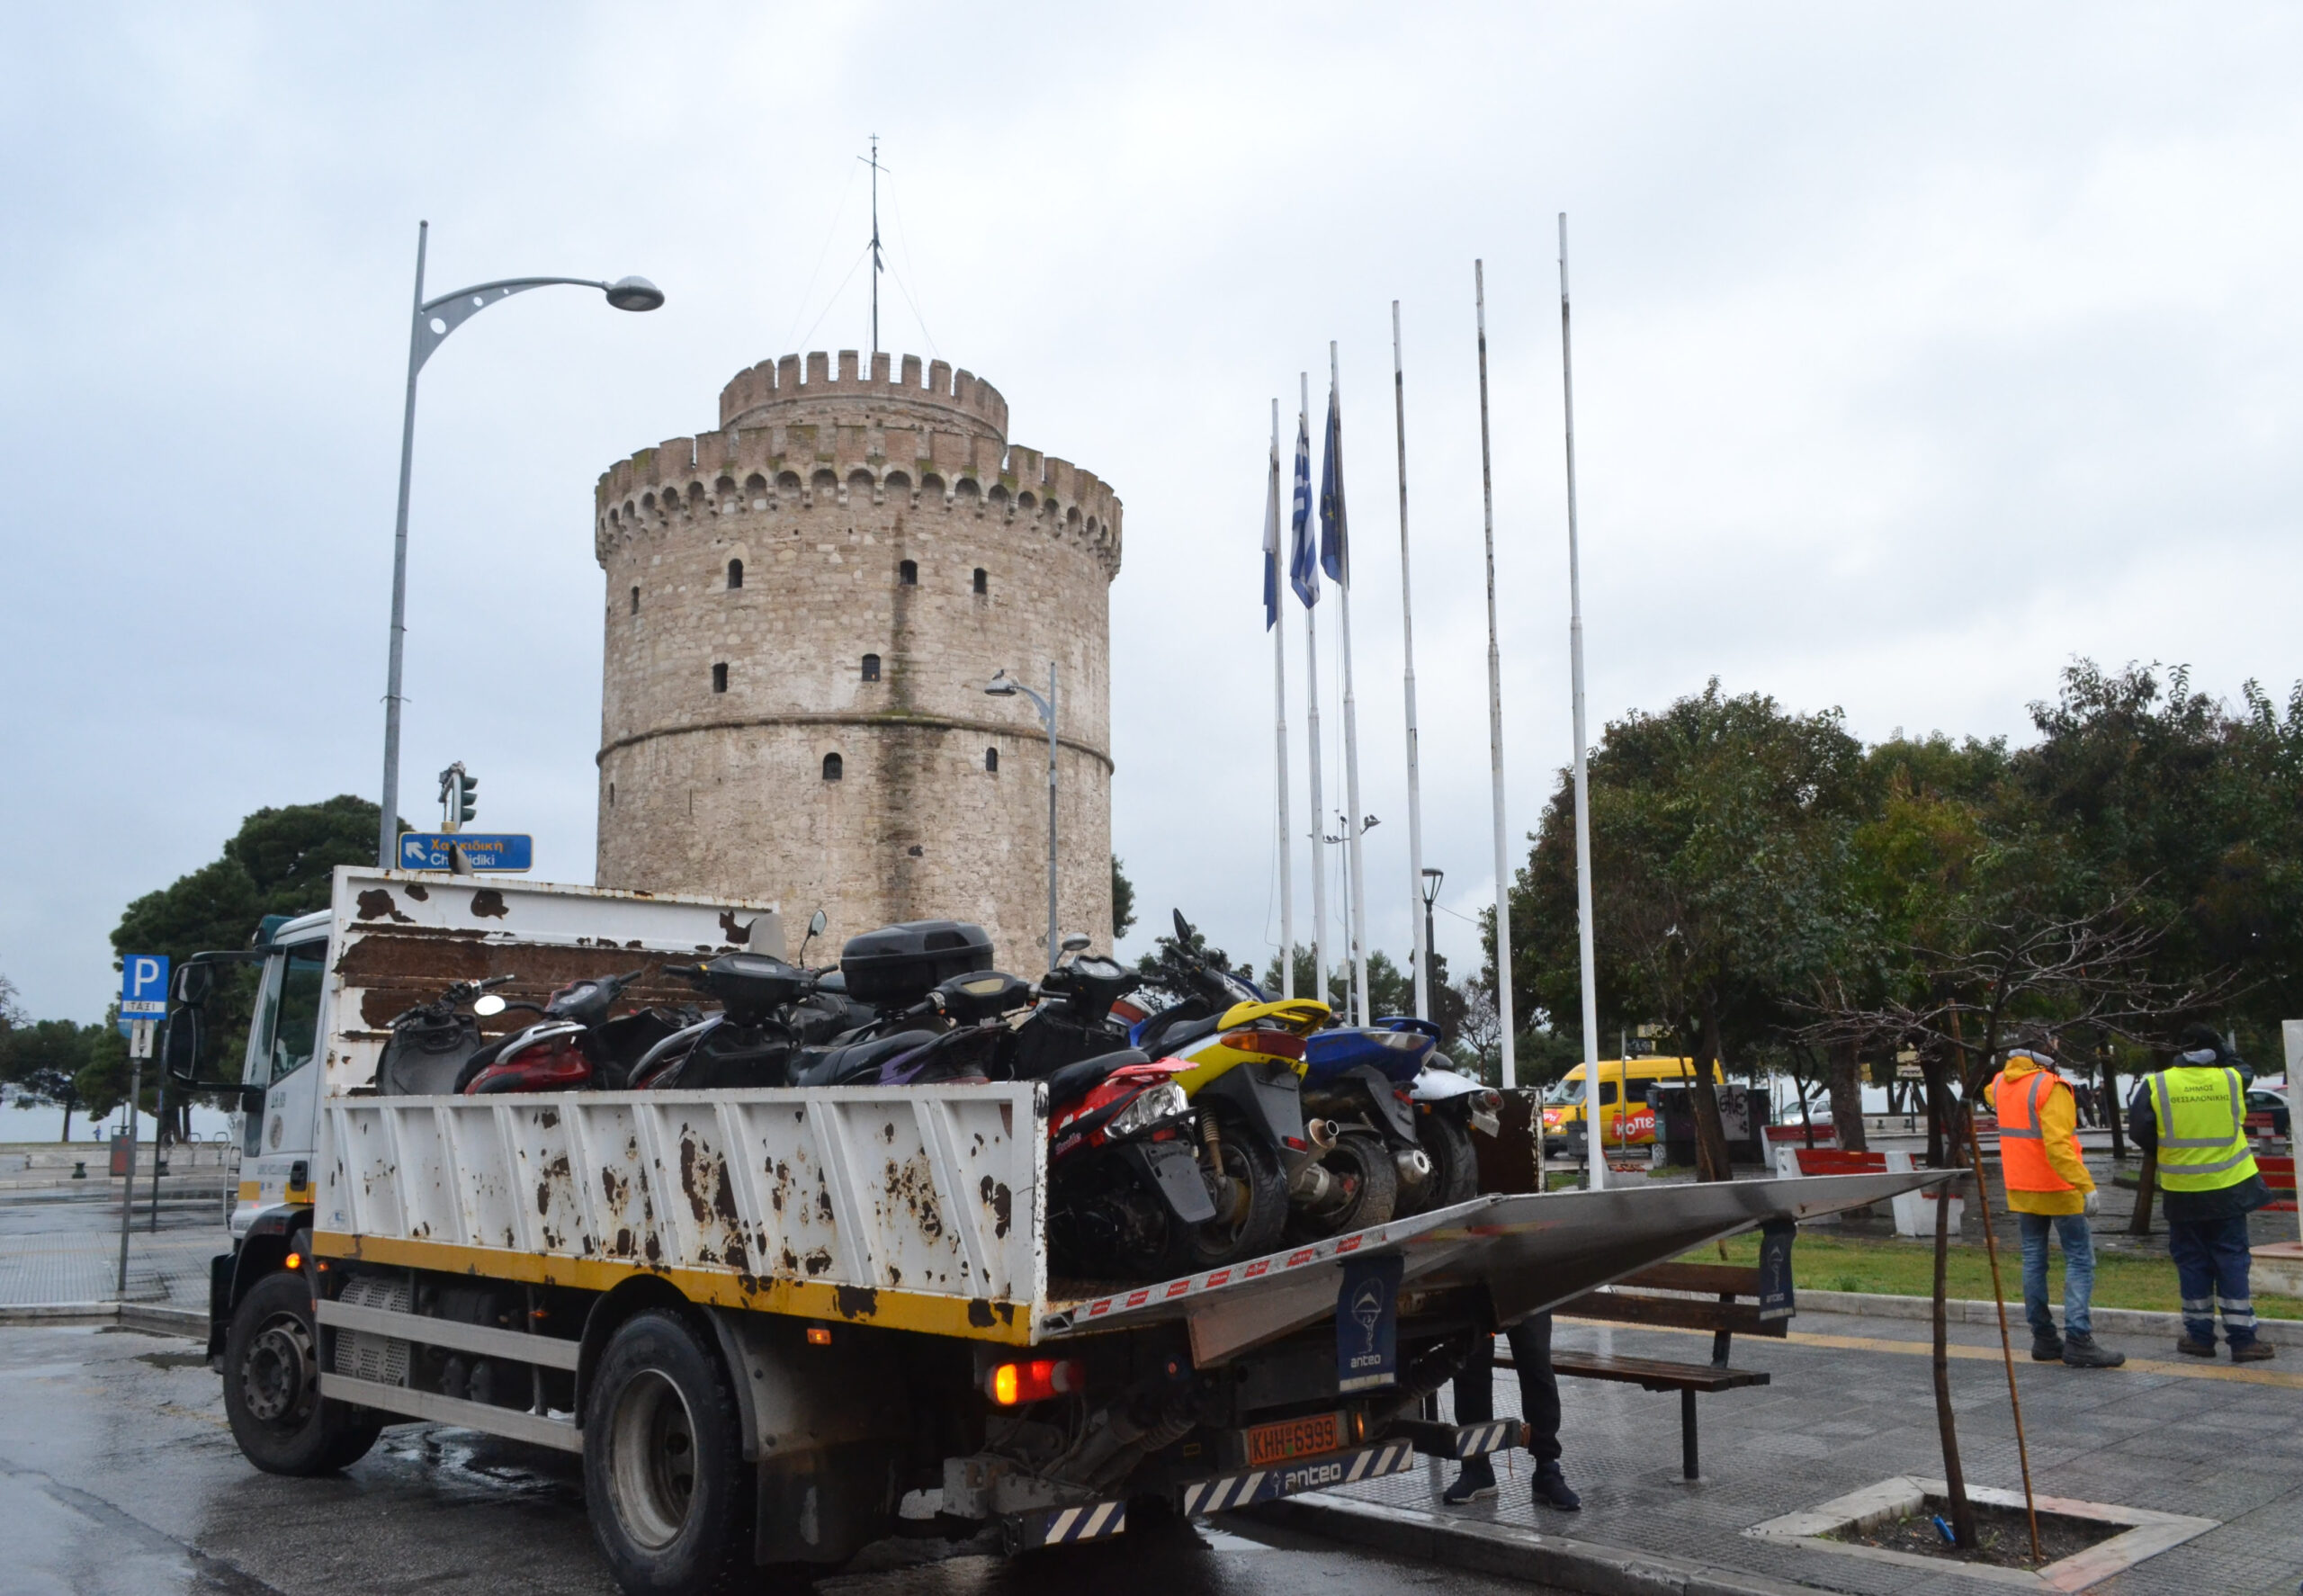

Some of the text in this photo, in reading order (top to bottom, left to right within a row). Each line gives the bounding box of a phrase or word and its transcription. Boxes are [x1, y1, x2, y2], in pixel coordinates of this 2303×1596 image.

[430, 853, 496, 865] Chidiki
[134, 958, 159, 997] P
[2183, 1084, 2214, 1092] ΔΗΜΟΣ
[2170, 1094, 2230, 1104] ΘΕΣΣΑΛΟΝΙΚΗΣ
[1350, 1354, 1382, 1368] anteo
[1285, 1462, 1342, 1491] anteo
